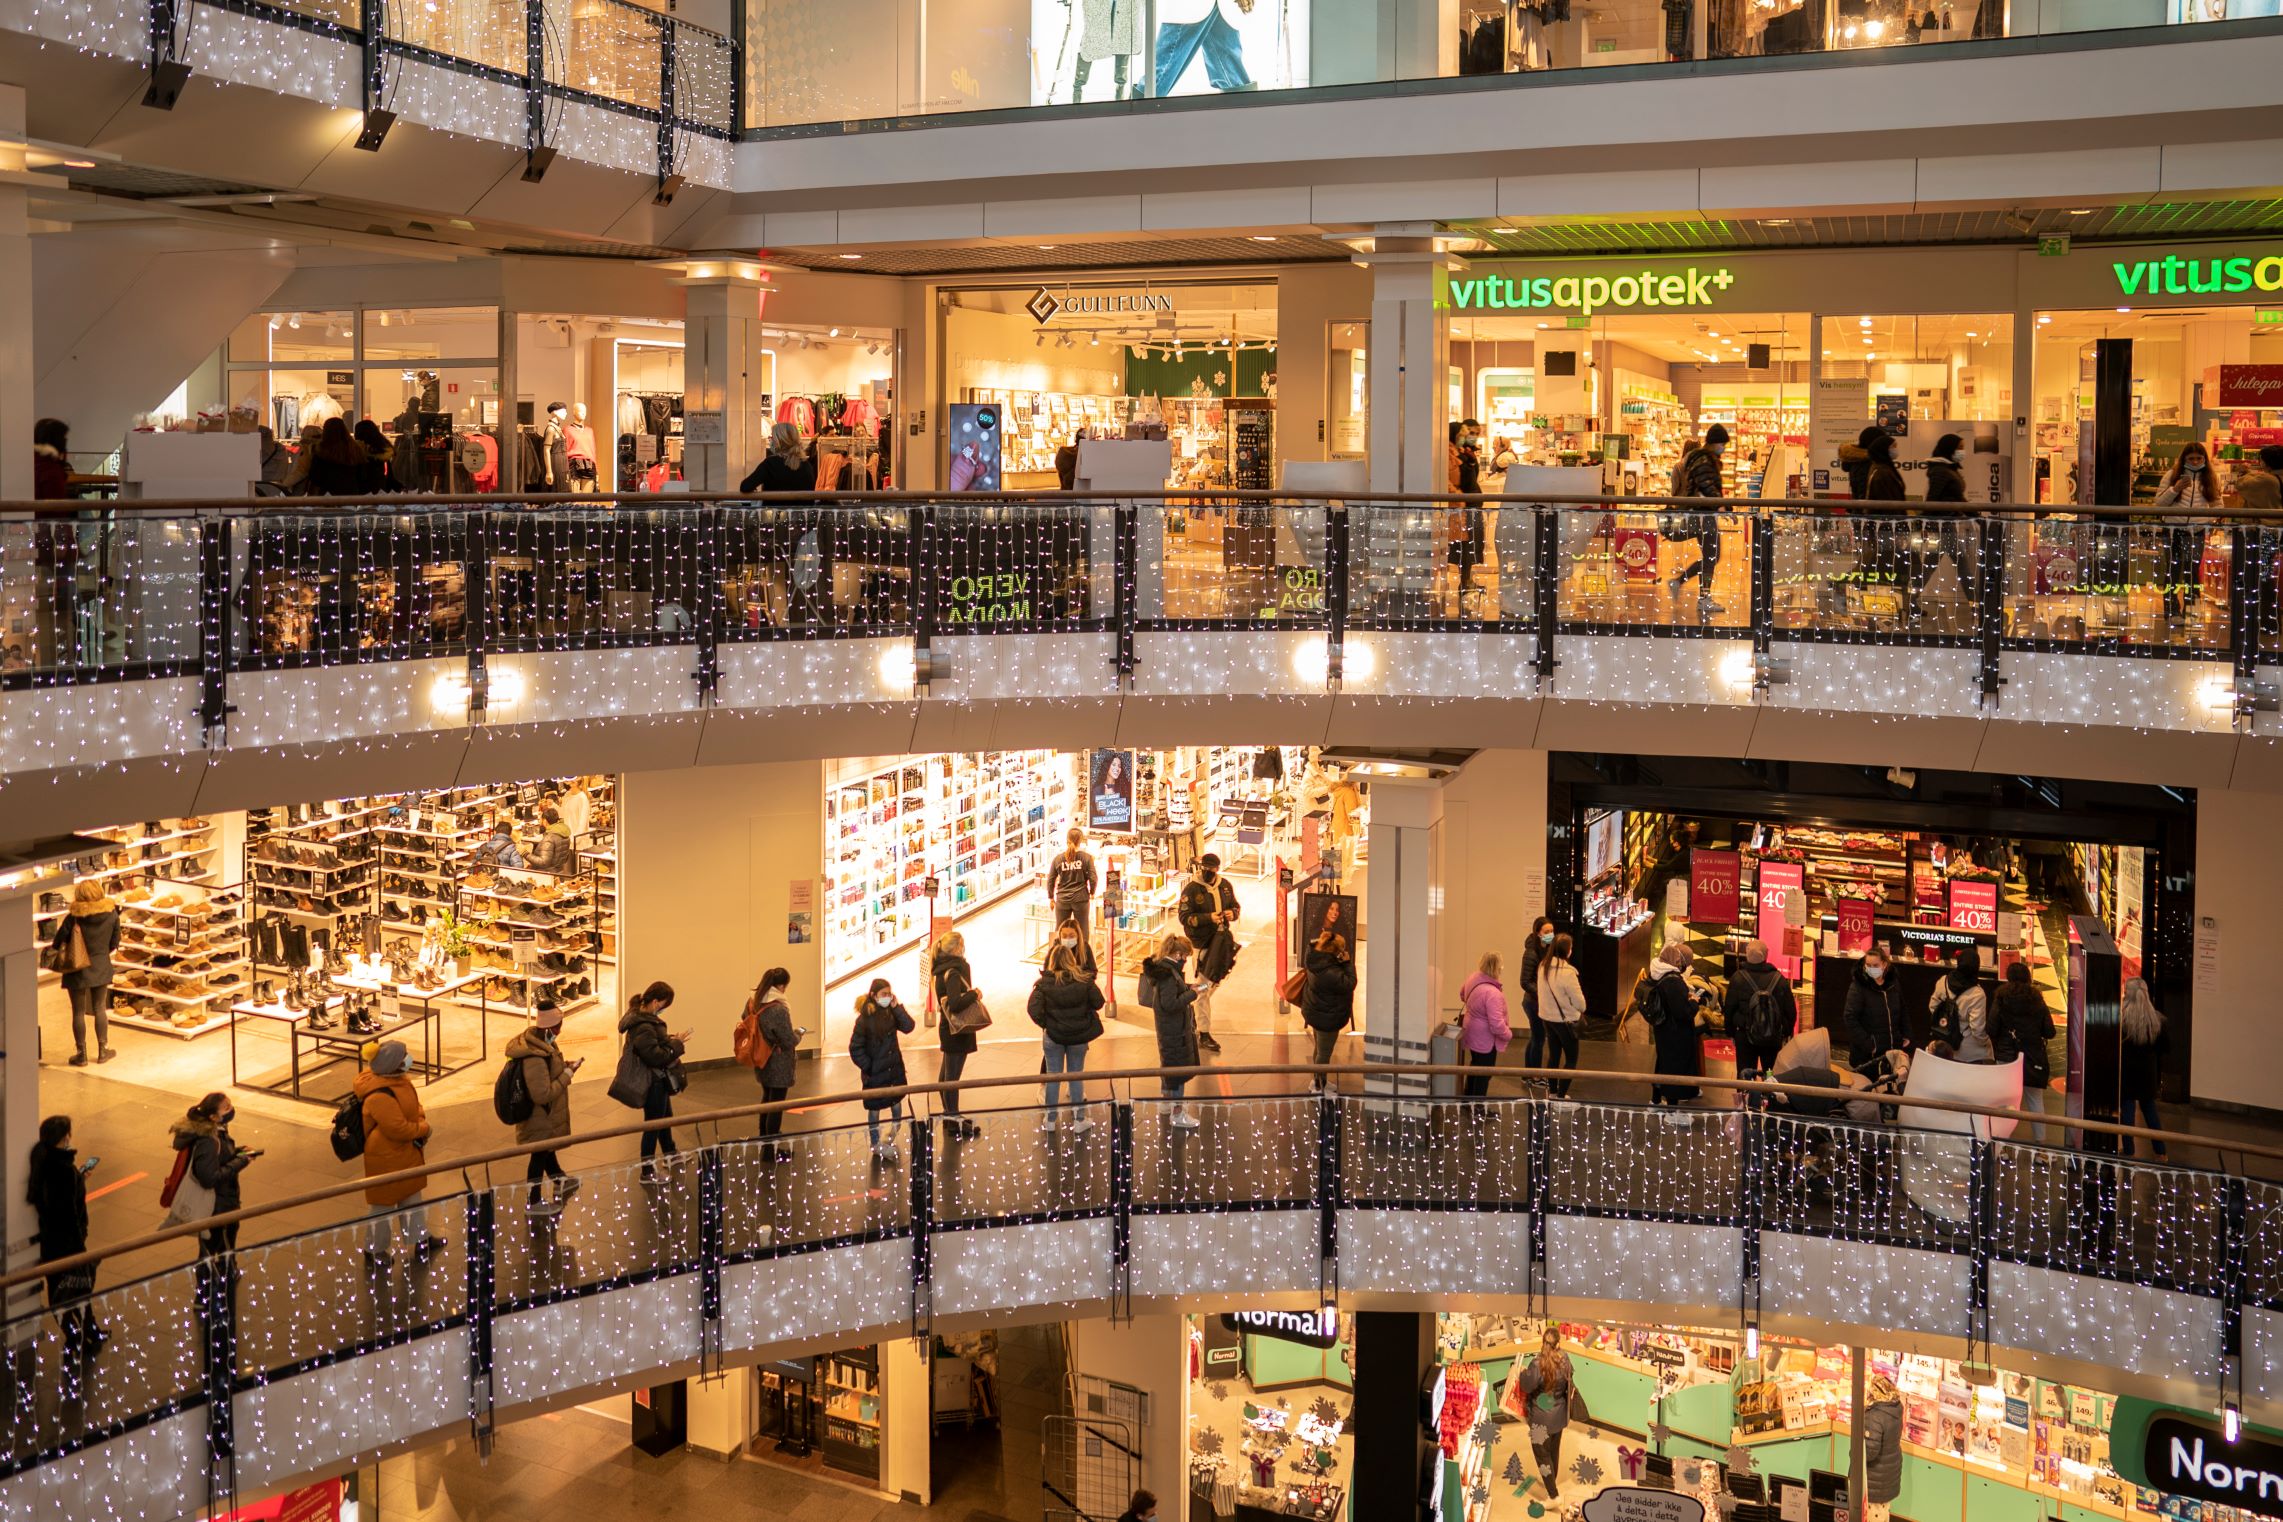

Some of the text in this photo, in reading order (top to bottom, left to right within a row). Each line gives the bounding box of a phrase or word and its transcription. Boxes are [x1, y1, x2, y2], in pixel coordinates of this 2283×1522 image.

[1064, 294, 1172, 313] GULLFUNN
[1819, 381, 1832, 389] Vis
[979, 413, 994, 424] 50%
[1098, 799, 1124, 808] BLACK
[1696, 877, 1733, 895] 40%
[1974, 903, 1994, 911] STORE
[1840, 918, 1870, 933] 40%
[1953, 911, 1992, 929] 40%
[1901, 929, 1976, 944] VICTORIA'S SECRET
[1213, 1350, 1236, 1361] Normal
[1625, 1505, 1647, 1517] delta
[1655, 1511, 1680, 1522] dette
[1665, 1500, 1682, 1513] ikke
